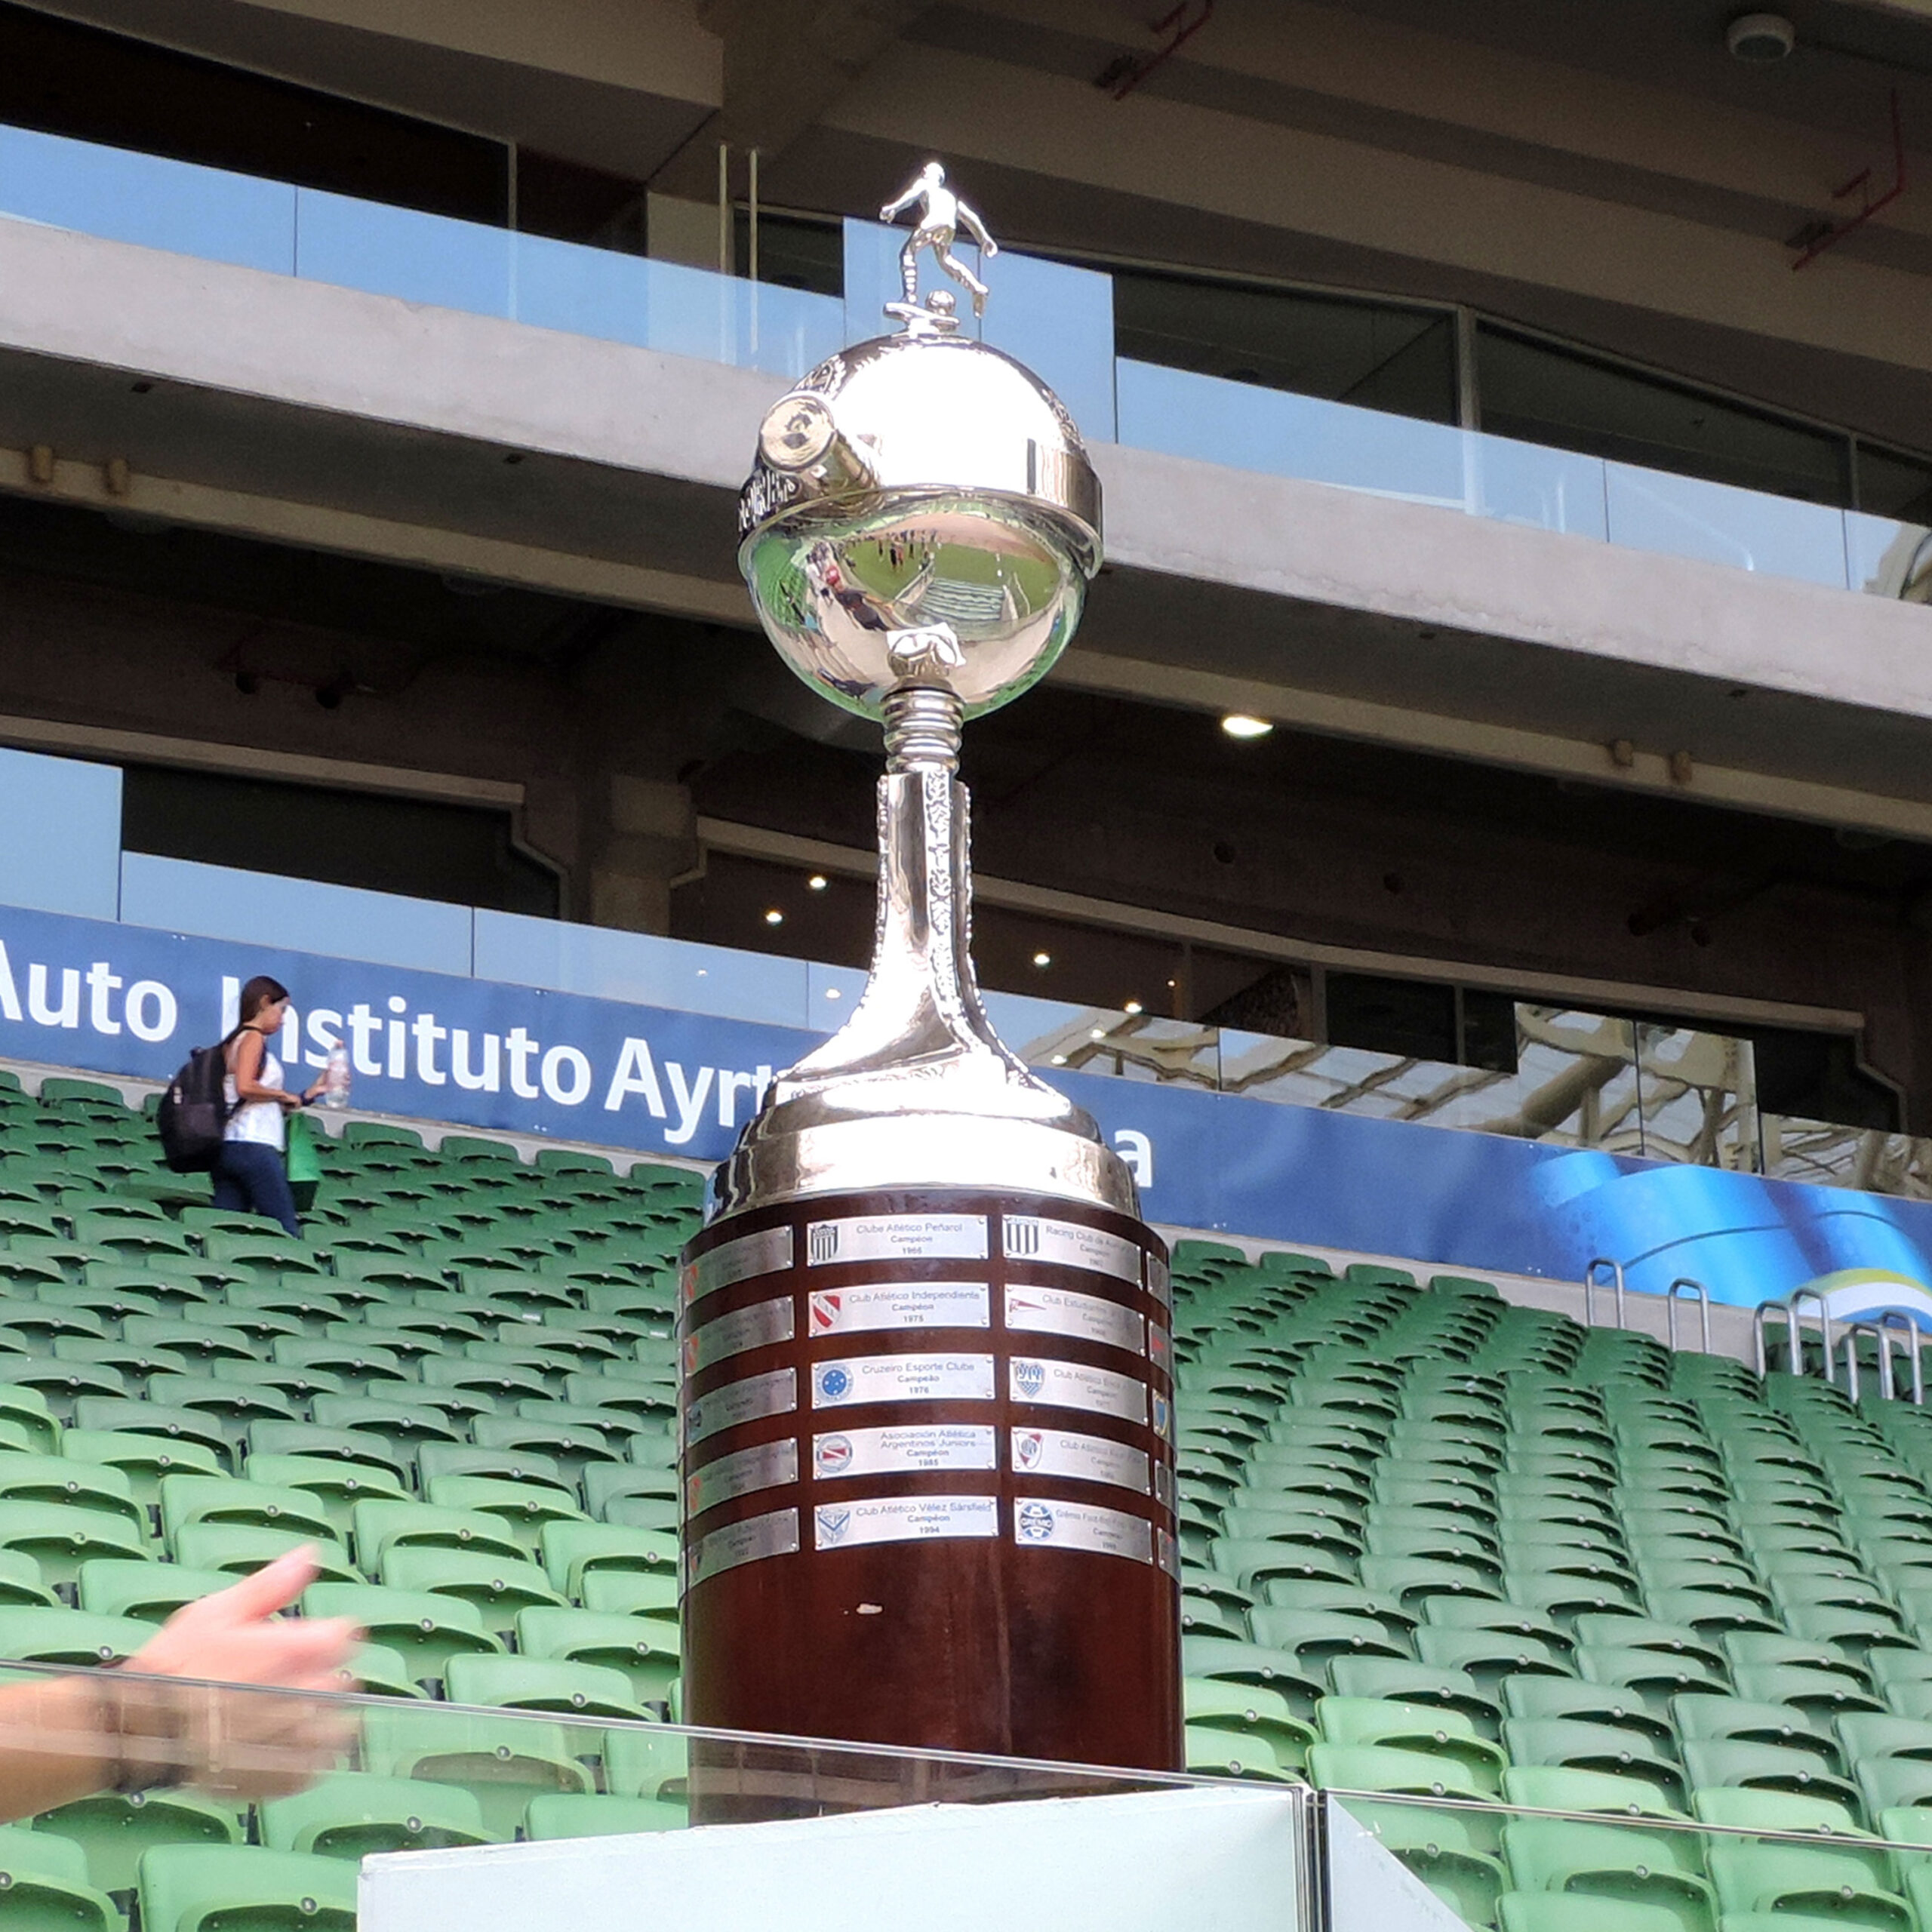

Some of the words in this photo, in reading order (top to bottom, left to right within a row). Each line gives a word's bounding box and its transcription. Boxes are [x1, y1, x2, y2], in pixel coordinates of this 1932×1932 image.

[925, 1222, 962, 1232] Peñarol
[849, 1294, 871, 1303] Club
[873, 1292, 909, 1302] Atlético
[912, 1291, 980, 1300] Independiente
[862, 1364, 903, 1374] Cruzeiro
[906, 1363, 943, 1373] Esporte
[946, 1361, 974, 1371] Clube
[881, 1440, 936, 1450] Argentinos
[939, 1439, 976, 1447] Juniors
[1060, 1439, 1079, 1451] Club
[856, 1507, 879, 1517] Club
[881, 1505, 916, 1515] Atlético
[918, 1503, 947, 1512] Vélez
